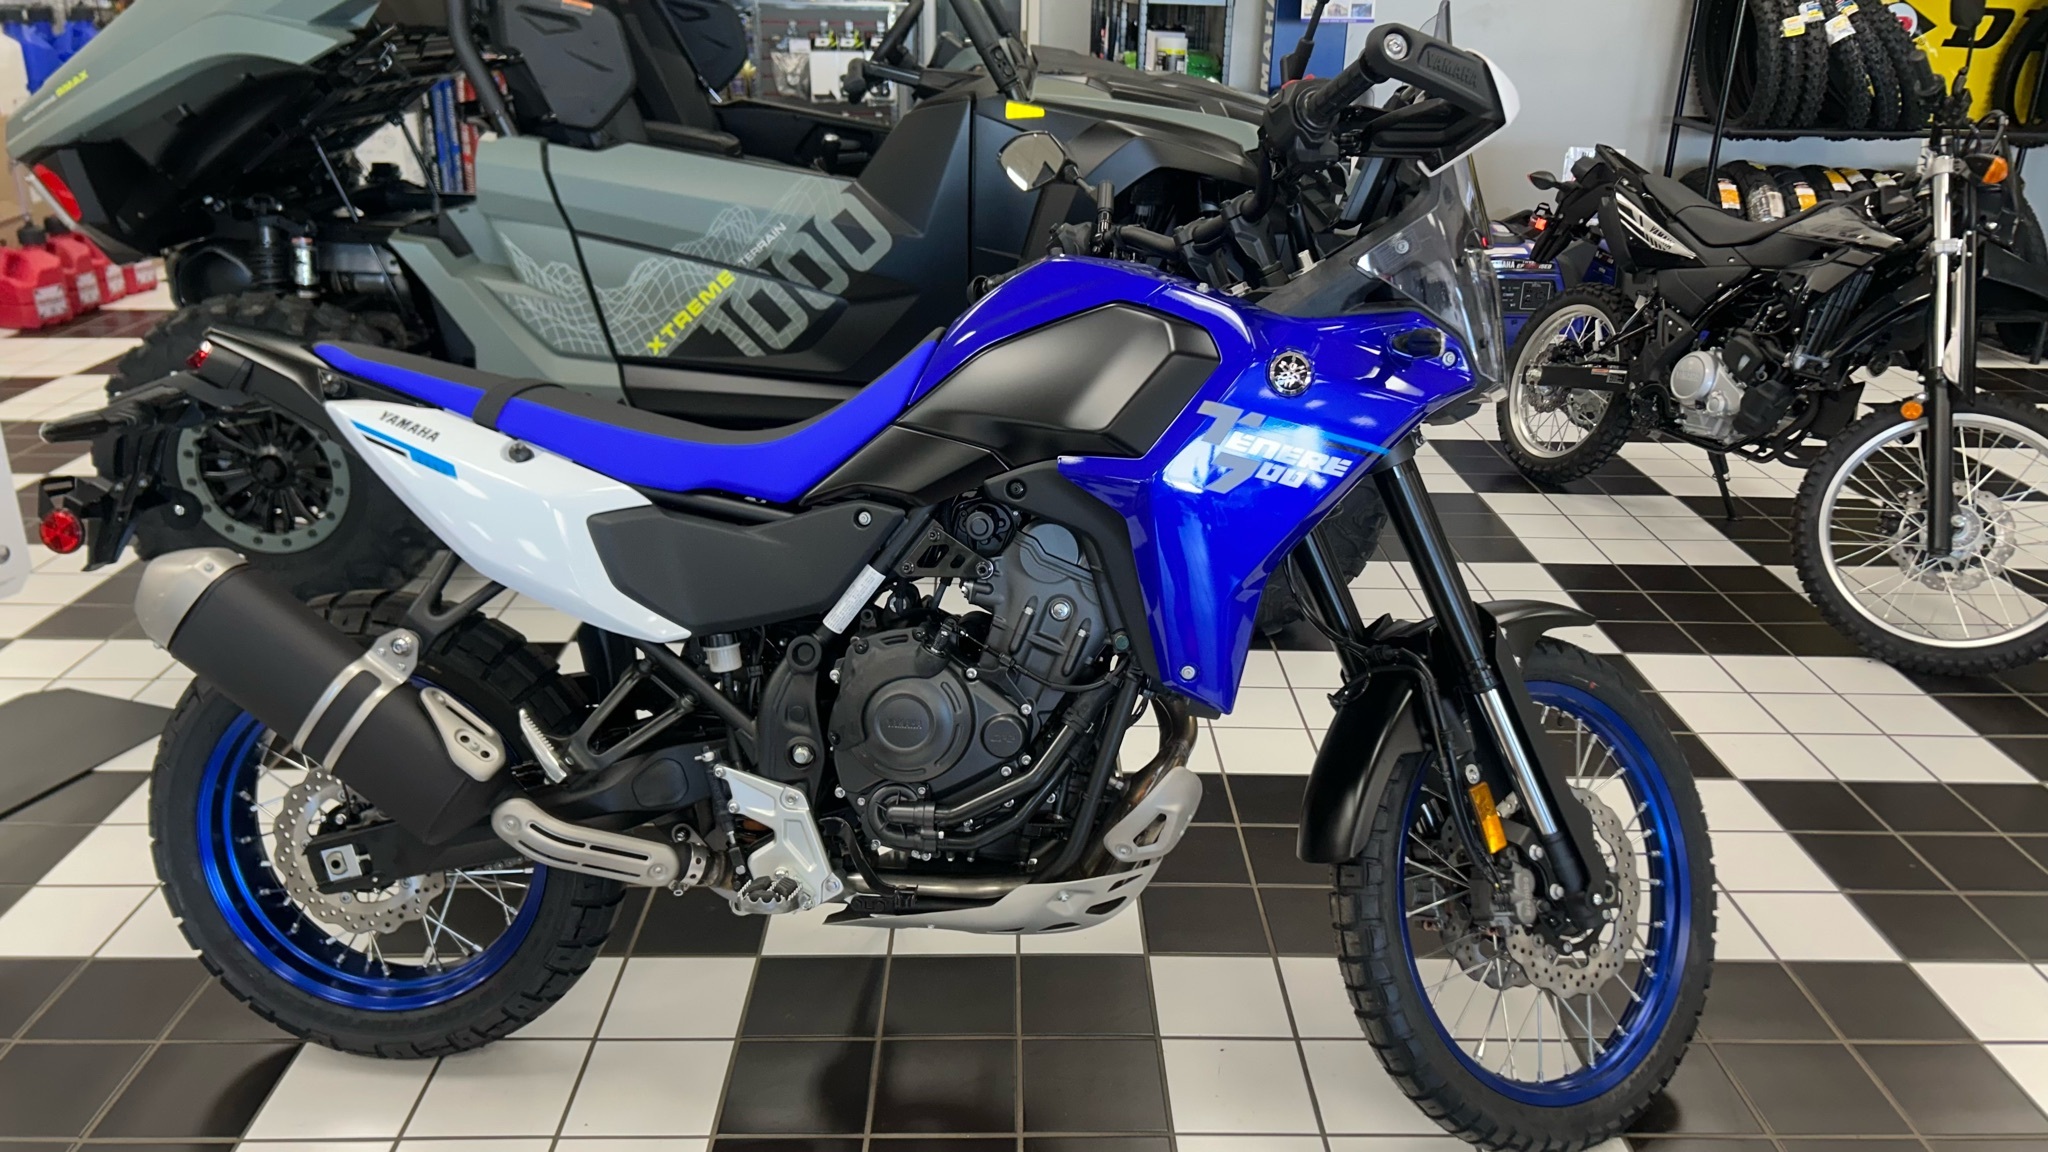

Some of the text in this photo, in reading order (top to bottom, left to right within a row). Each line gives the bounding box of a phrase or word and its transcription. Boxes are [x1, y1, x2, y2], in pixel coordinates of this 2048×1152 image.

[1426, 51, 1477, 88] YAMAHA
[647, 222, 787, 356] XTREME TERRAIN
[700, 192, 893, 357] 1000
[379, 411, 440, 442] YAMAHA
[1204, 451, 1308, 494] 700
